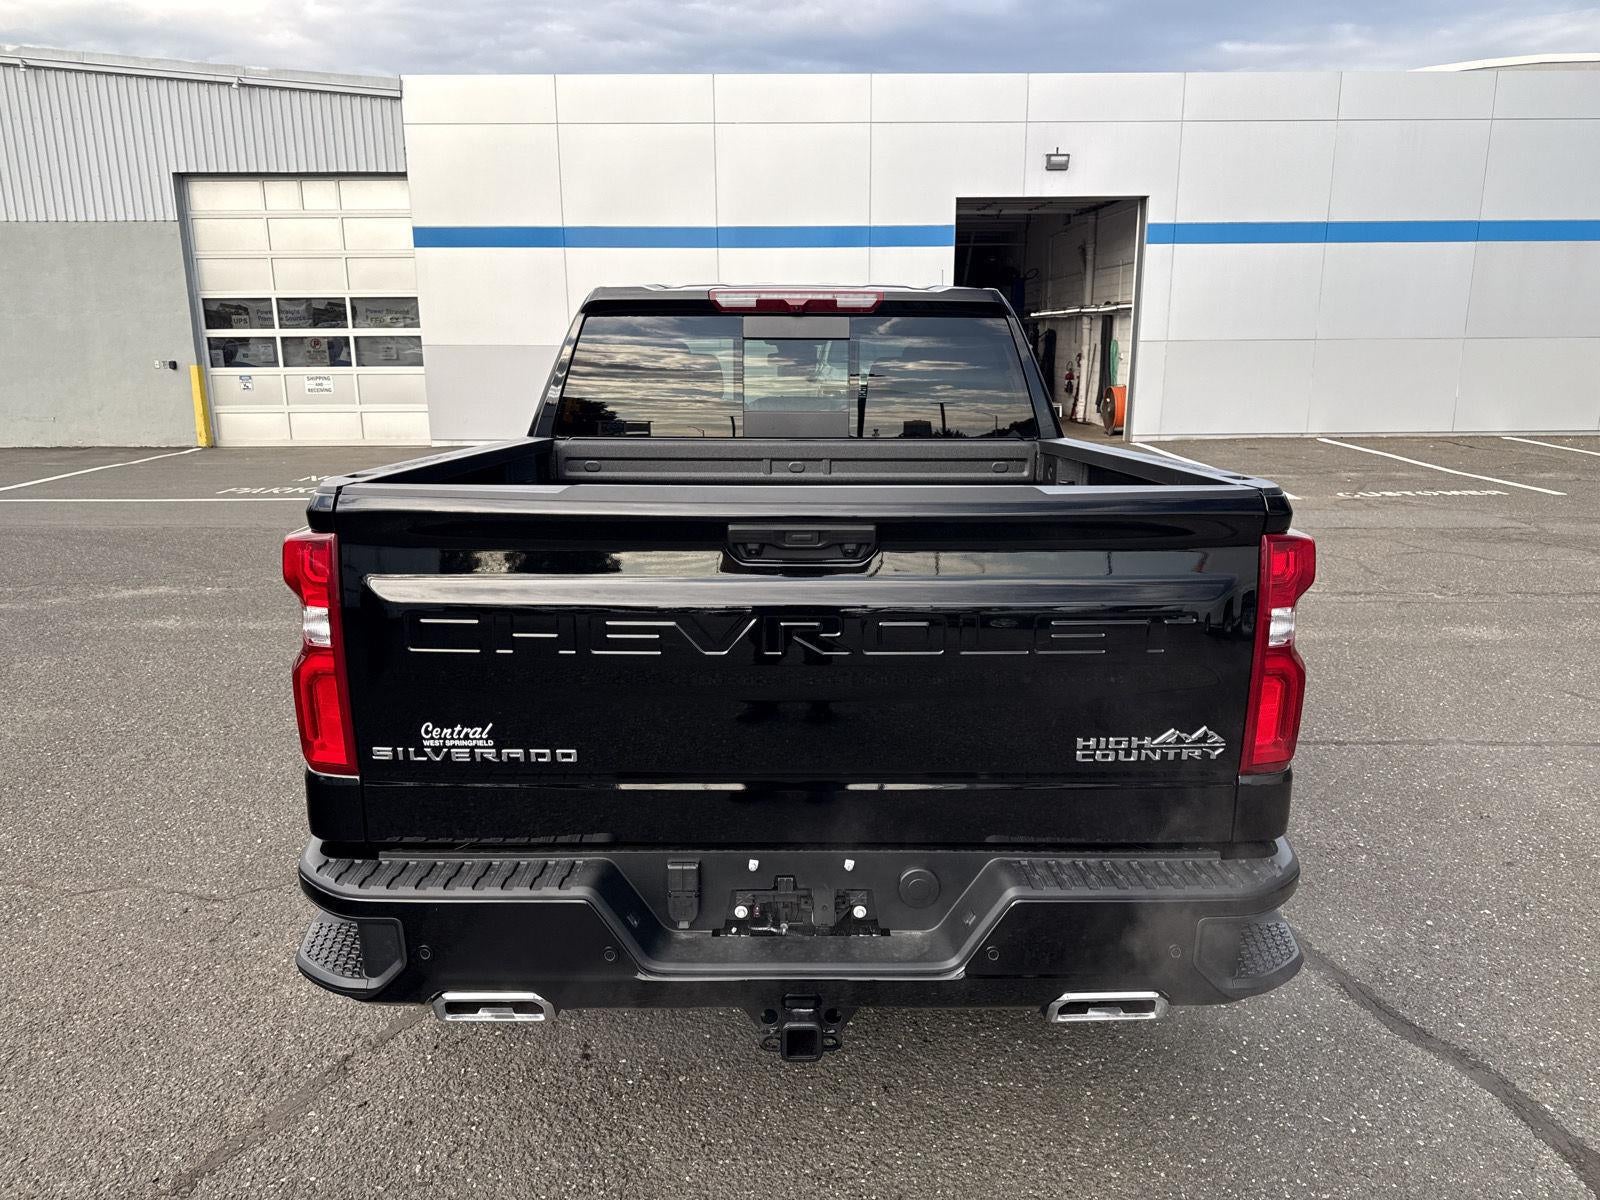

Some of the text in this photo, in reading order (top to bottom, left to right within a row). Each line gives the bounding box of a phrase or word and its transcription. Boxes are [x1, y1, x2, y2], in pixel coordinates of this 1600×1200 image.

[1336, 489, 1510, 498] CUSTOMER
[404, 612, 1198, 657] CHEVROLET
[421, 721, 494, 739] Central
[423, 739, 494, 747] WEST SPRINGFIELD
[1076, 736, 1152, 749] HIGH
[372, 746, 578, 763] SILVERADO
[1075, 748, 1225, 762] COUNTRY
